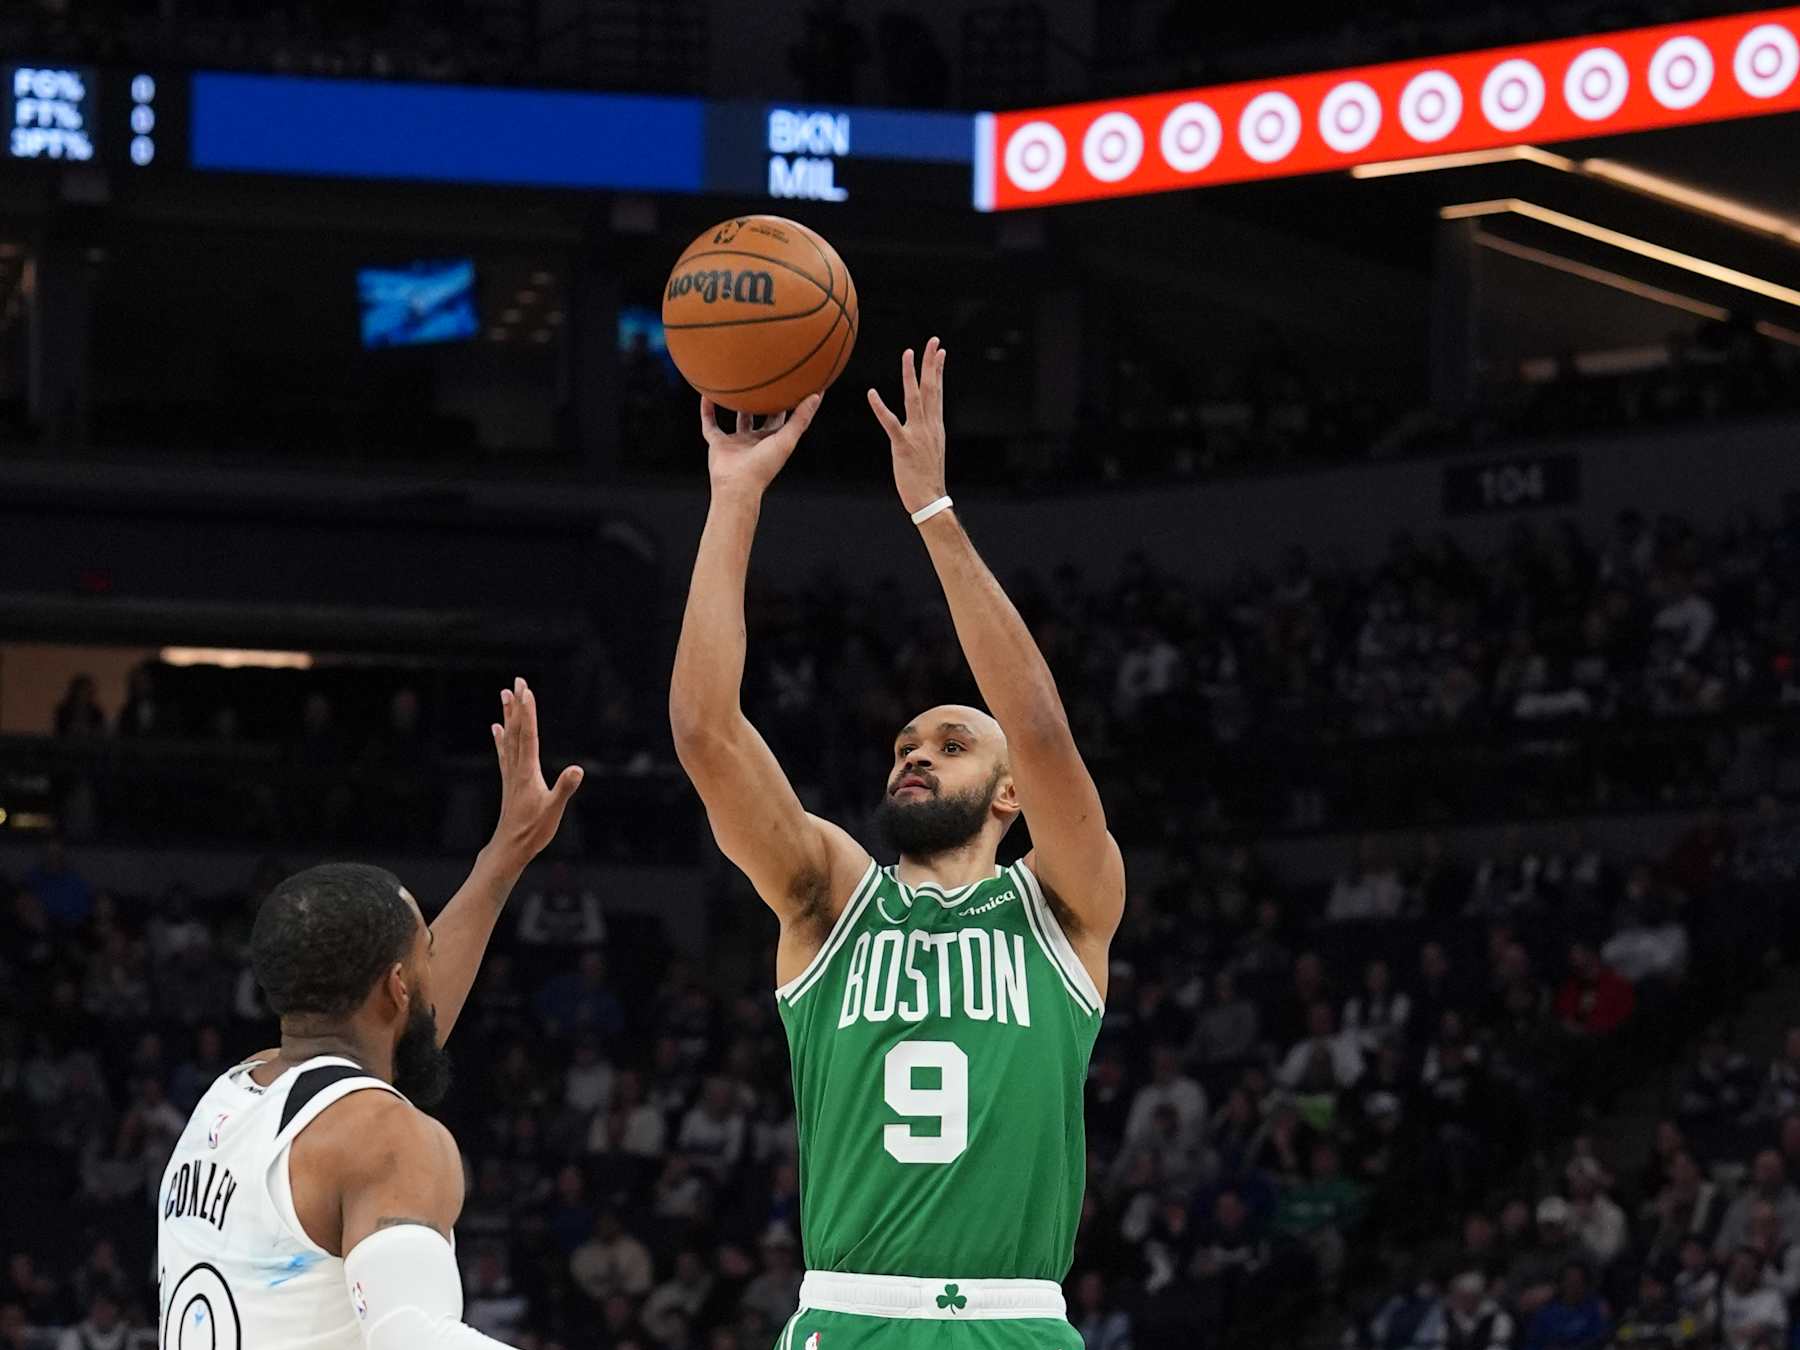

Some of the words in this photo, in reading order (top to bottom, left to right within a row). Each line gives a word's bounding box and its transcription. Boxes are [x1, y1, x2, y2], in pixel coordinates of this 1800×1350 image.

[130, 74, 156, 104] 0
[130, 104, 156, 134] 0
[767, 108, 851, 156] BKN
[130, 134, 156, 167] 0
[767, 155, 849, 202] MIL
[668, 269, 775, 306] Wilson
[1479, 463, 1545, 505] 104
[958, 889, 1017, 918] Amica
[837, 927, 1031, 1030] BOSTON
[883, 1040, 969, 1164] 9
[164, 1159, 238, 1232] CONLEY
